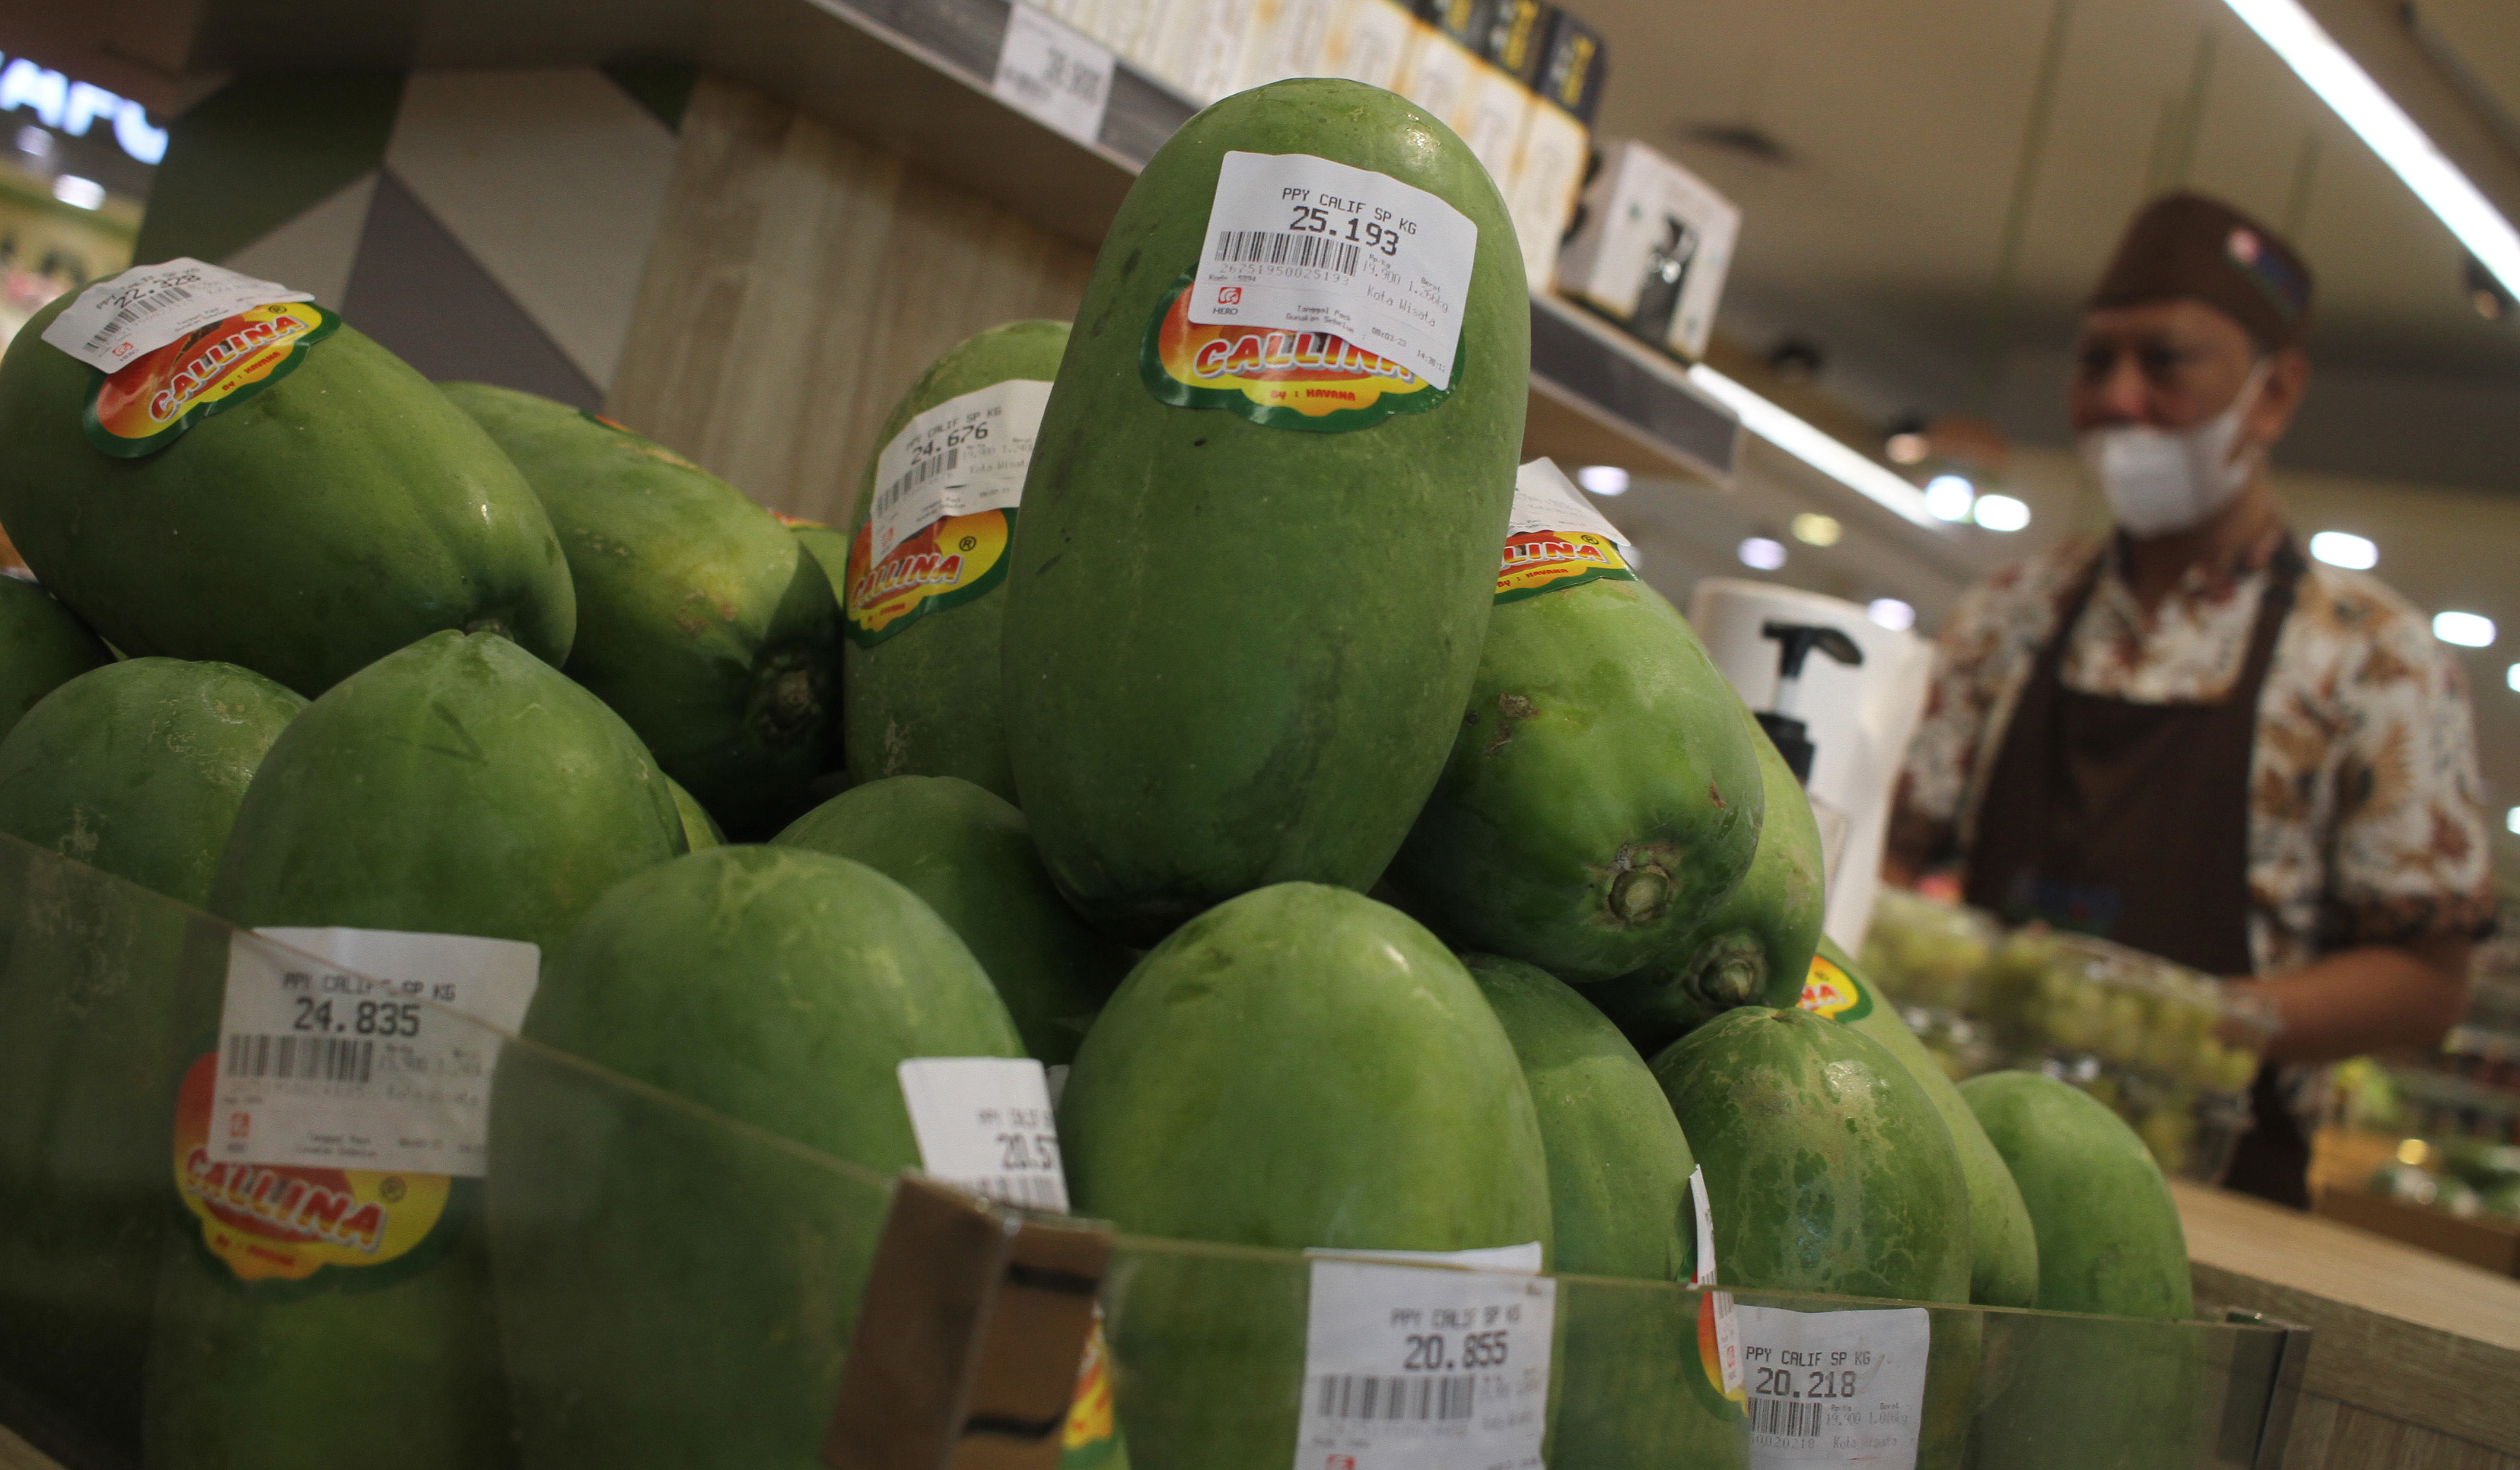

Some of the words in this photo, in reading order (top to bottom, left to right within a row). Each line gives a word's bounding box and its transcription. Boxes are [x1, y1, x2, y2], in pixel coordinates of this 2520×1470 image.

[1282, 187, 1310, 201] PPY
[1320, 194, 1366, 214] CALIF
[1374, 207, 1392, 222] SP
[1399, 218, 1418, 235] KG
[1288, 206, 1399, 256] 25.193
[1213, 307, 1239, 316] HERO
[1366, 284, 1394, 306] Kota
[1399, 298, 1436, 327] Wisata
[149, 316, 309, 422] CALLINA
[244, 351, 281, 374] HAVANA
[1306, 388, 1357, 402] HAVANA
[911, 421, 989, 465] 24.676
[1525, 568, 1569, 579] HAVANA
[293, 995, 421, 1037] 24.835
[996, 1132, 1057, 1170] 20.5
[187, 1146, 387, 1256] CALLINA
[1404, 1329, 1509, 1371] 20.855
[1746, 1346, 1772, 1362] PPY
[1781, 1350, 1823, 1366] CALIF
[1831, 1351, 1847, 1366] SP
[1855, 1351, 1870, 1366] KG
[1755, 1366, 1856, 1398] 20.218
